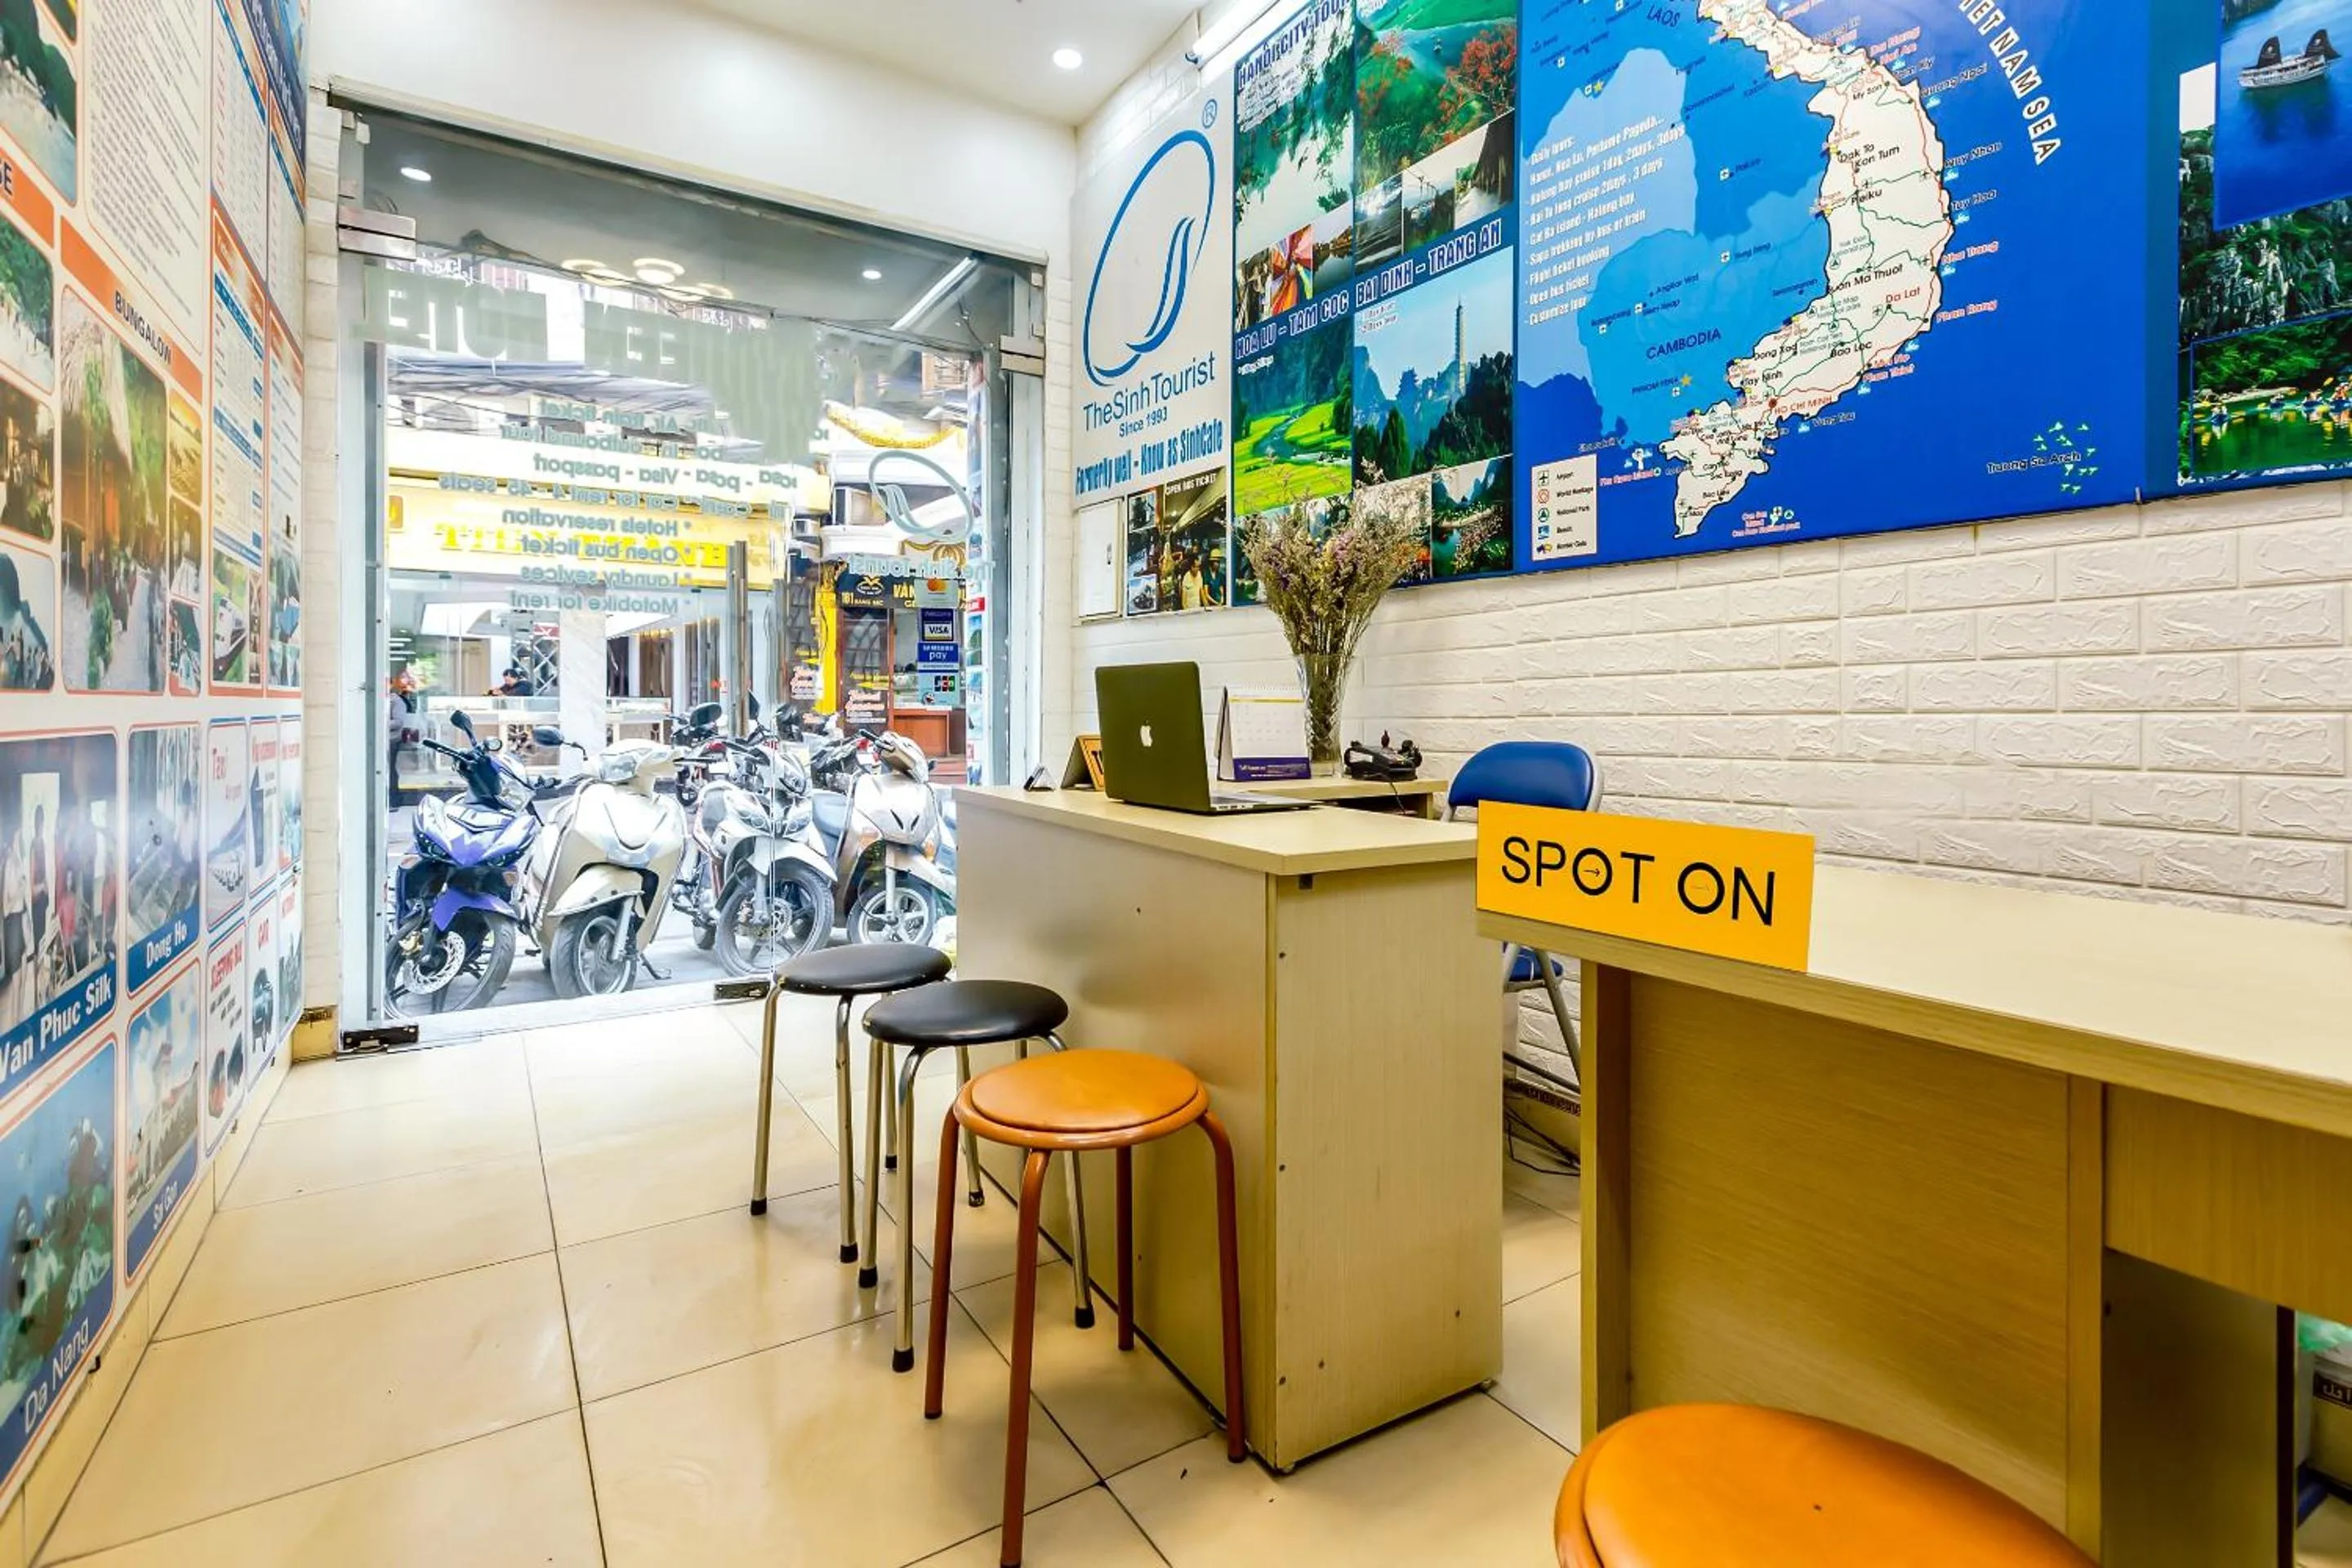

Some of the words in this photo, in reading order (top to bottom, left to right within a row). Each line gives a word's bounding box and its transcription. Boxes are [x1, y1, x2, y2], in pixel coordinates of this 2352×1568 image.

[1646, 5, 1680, 27] LAOS
[1991, 29, 2040, 97] NAM
[2024, 97, 2060, 163] SEA
[1878, 146, 1900, 161] Tum
[1356, 276, 1379, 308] BAI
[1381, 259, 1414, 296] DINH
[1428, 231, 1477, 276] TRANG
[1480, 217, 1501, 255] AN
[1873, 263, 1904, 280] Thuot
[1886, 292, 1901, 304] Da
[1904, 286, 1921, 299] Lat
[114, 289, 172, 367] BUNGALOW
[1235, 333, 1259, 360] HOA
[1260, 323, 1277, 351] LU
[1289, 303, 1319, 336] TAM
[1321, 290, 1349, 323] COC
[1646, 327, 1722, 360] CAMBODIA
[1807, 395, 1833, 409] MINH
[1119, 418, 1144, 439] Since
[1146, 405, 1169, 428] 1993
[1167, 436, 1179, 468] as
[928, 626, 950, 635] VISA
[929, 651, 947, 661] pay
[933, 675, 956, 693] JCB
[1501, 835, 1655, 904] SPOT
[1677, 862, 1776, 927] ON
[146, 933, 173, 969] Dong
[174, 919, 188, 947] Ho
[40, 1000, 81, 1052] Phuc
[85, 972, 111, 1015] Silk
[24, 1381, 48, 1436] Da
[51, 1316, 90, 1383] Nang
